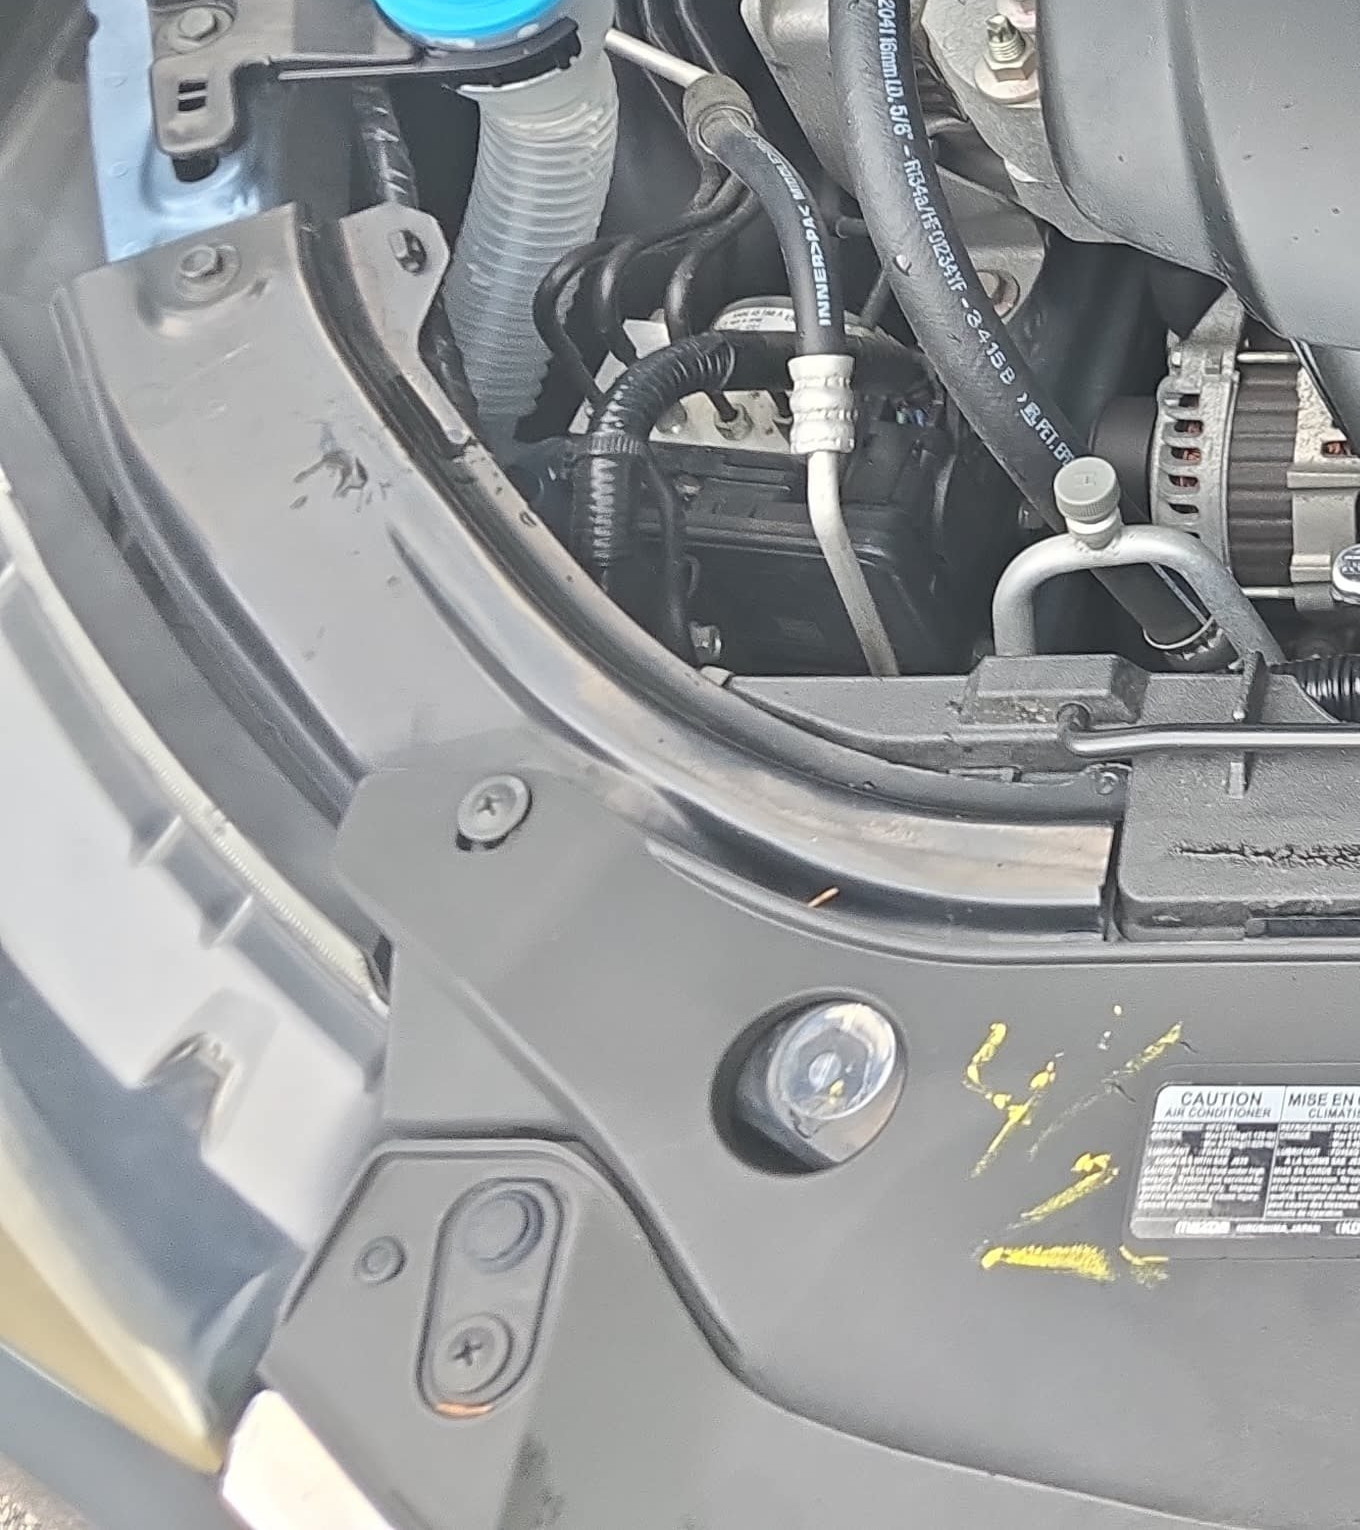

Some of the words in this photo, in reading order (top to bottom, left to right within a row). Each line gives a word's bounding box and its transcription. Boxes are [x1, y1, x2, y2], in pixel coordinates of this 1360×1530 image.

[1180, 1091, 1263, 1107] CAUTION
[1287, 1092, 1331, 1107] MISE
[1331, 1093, 1354, 1106] EN
[1164, 1107, 1187, 1119] AIR
[1188, 1107, 1272, 1119] CONDITIONER
